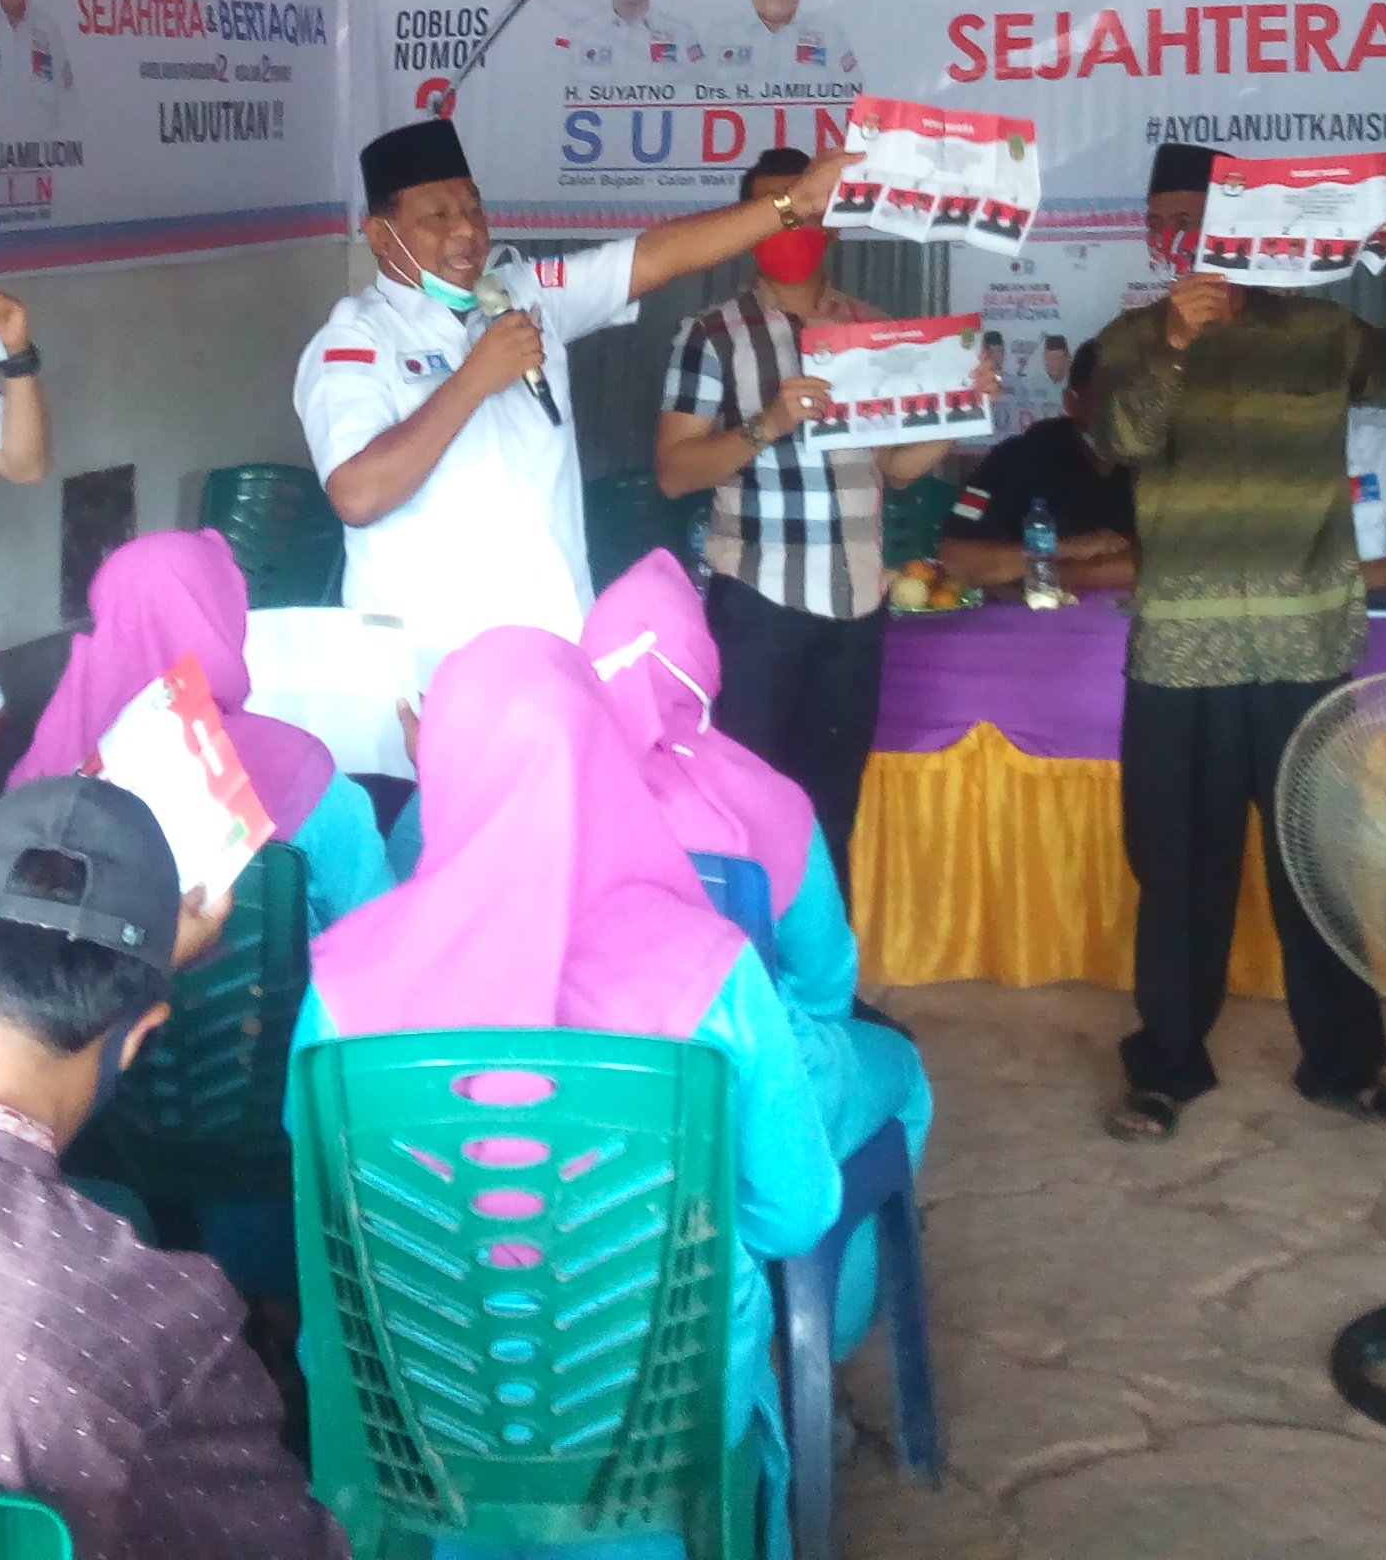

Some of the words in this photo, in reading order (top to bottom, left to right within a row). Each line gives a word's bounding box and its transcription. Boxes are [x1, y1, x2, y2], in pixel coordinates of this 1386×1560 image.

[396, 7, 489, 40] COBLOS
[565, 86, 583, 101] H.
[589, 84, 676, 101] SUYATNO
[695, 82, 730, 100] Drs.
[736, 83, 757, 100] H.
[761, 81, 864, 100] JAMILUDIN
[159, 100, 269, 144] LANJUTKAN
[558, 174, 596, 187] Calon
[600, 174, 645, 190] Bupati
[657, 173, 695, 187] Calon
